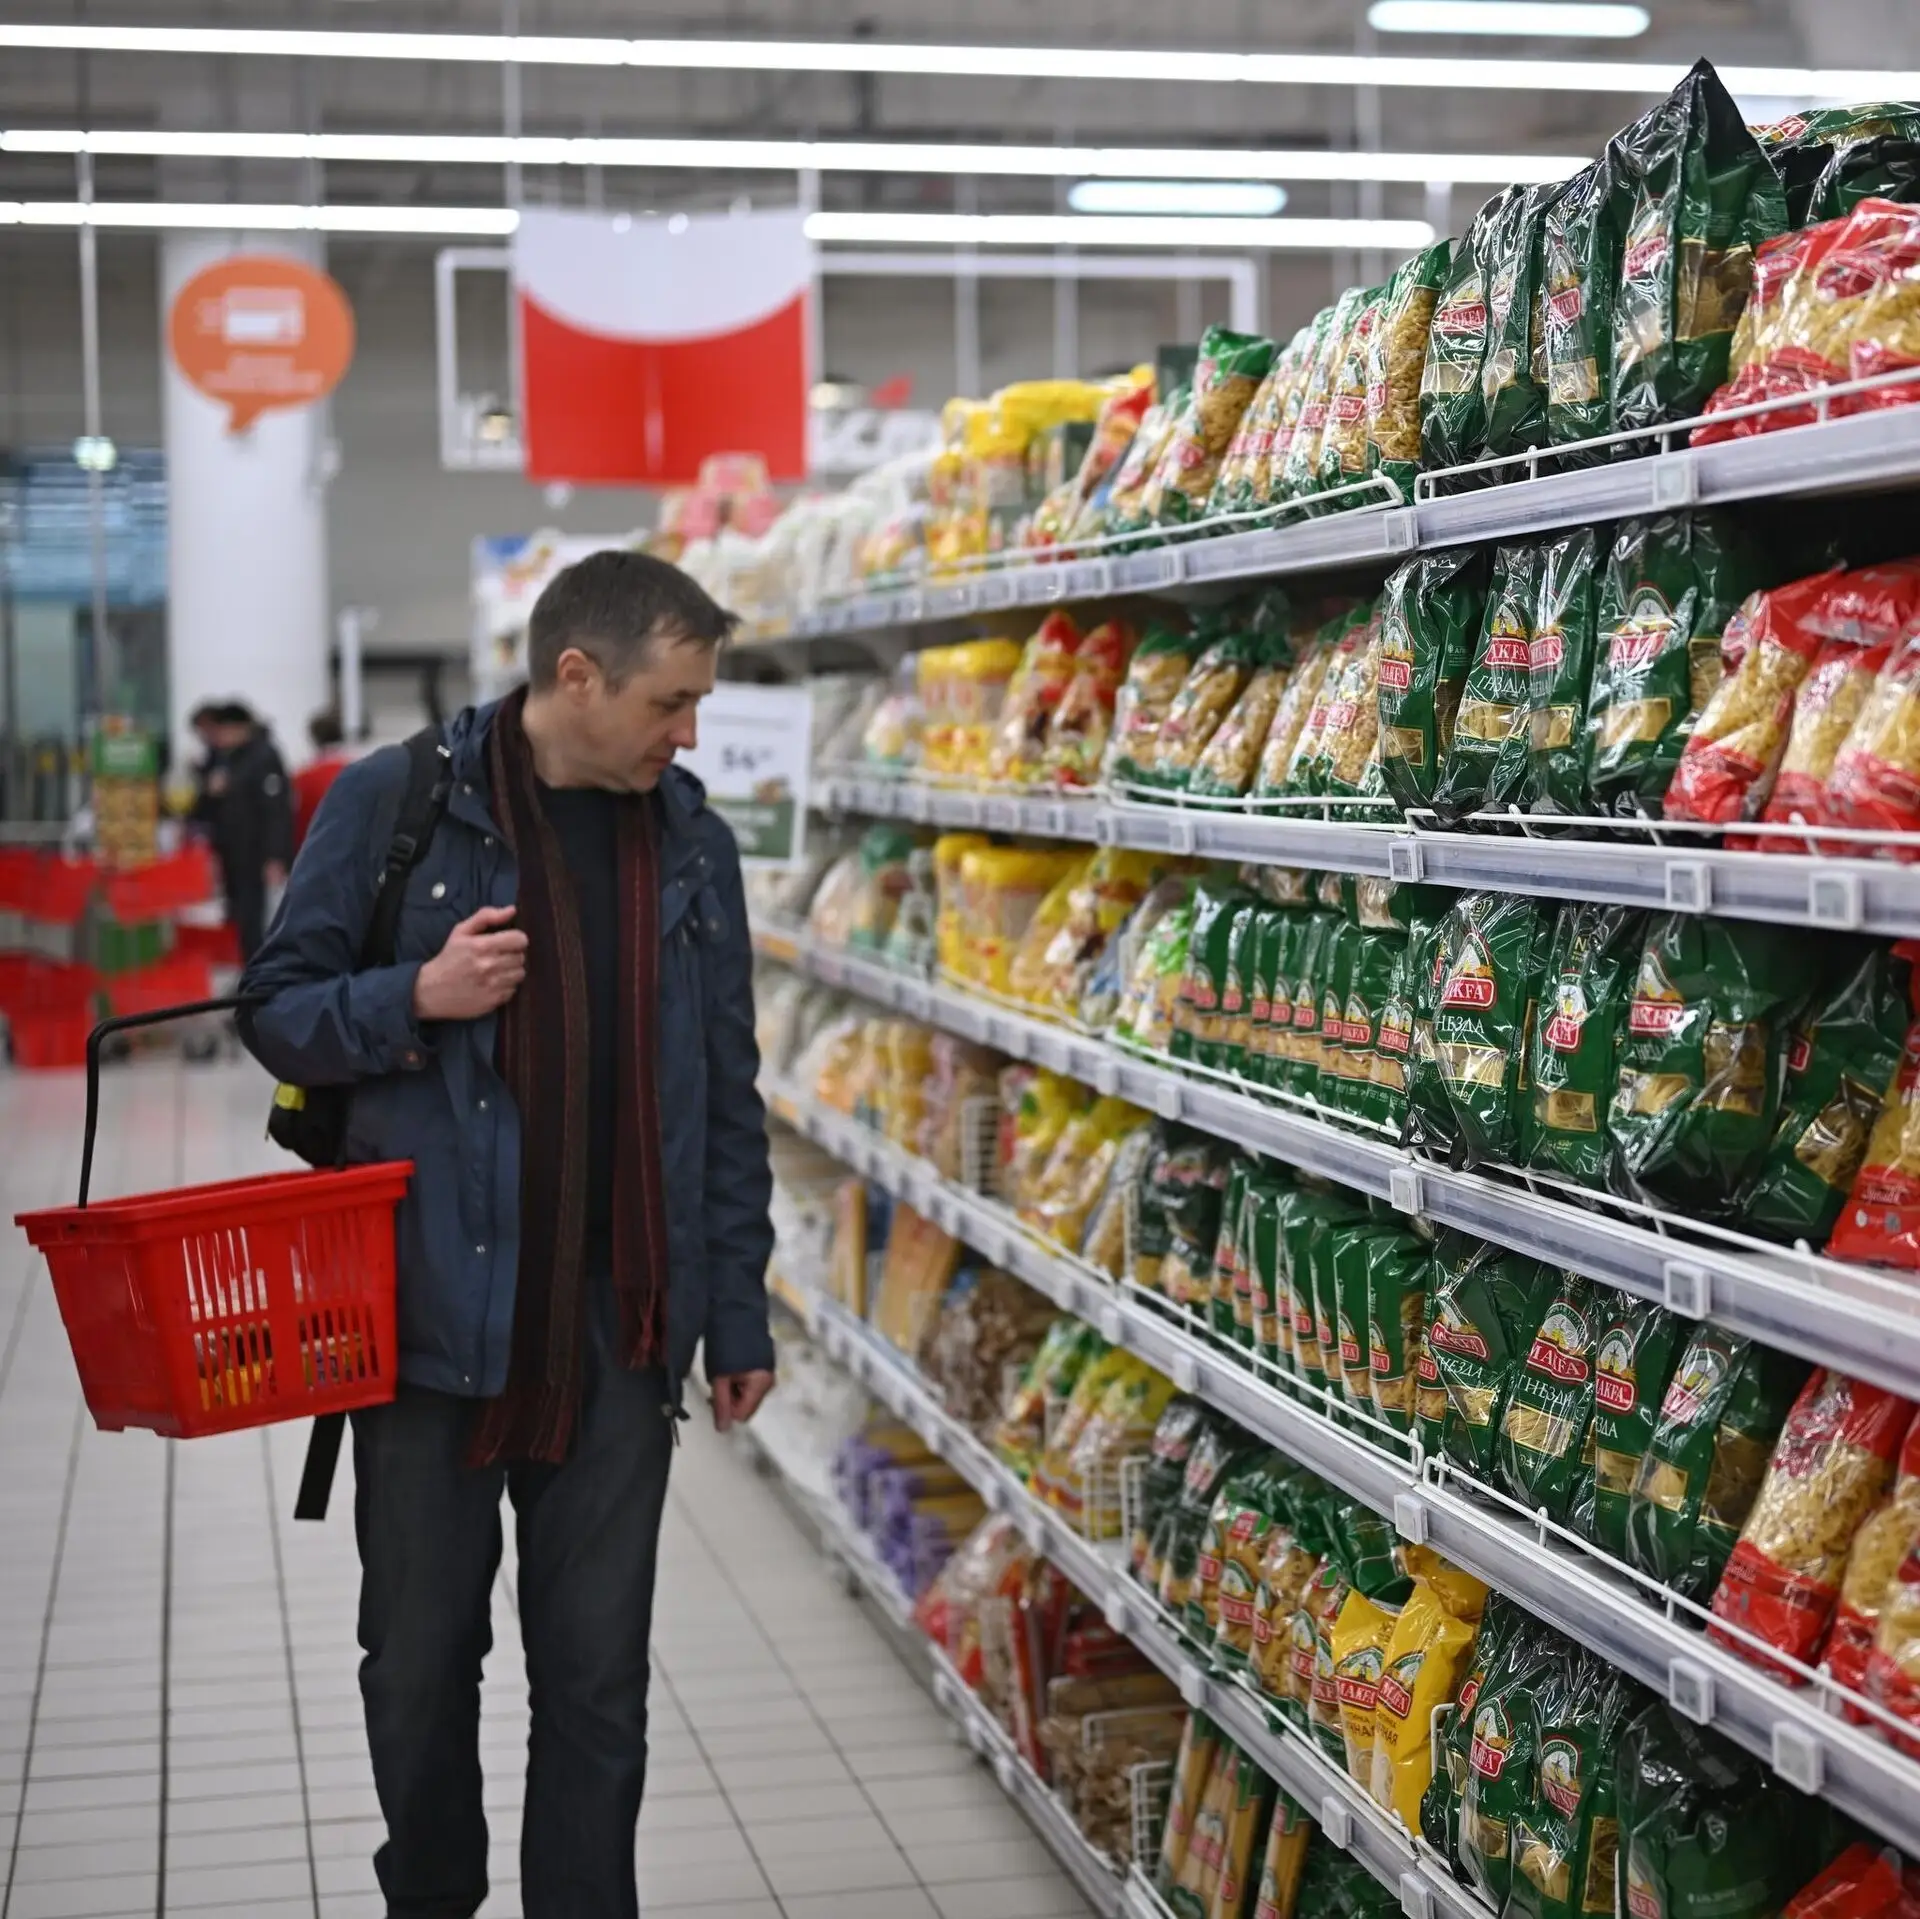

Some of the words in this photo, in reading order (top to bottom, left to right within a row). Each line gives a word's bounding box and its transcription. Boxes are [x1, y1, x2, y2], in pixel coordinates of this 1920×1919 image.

[1489, 643, 1527, 661] AKFA
[1447, 982, 1485, 1001] KFA
[1436, 1016, 1485, 1034] НЕЗДА
